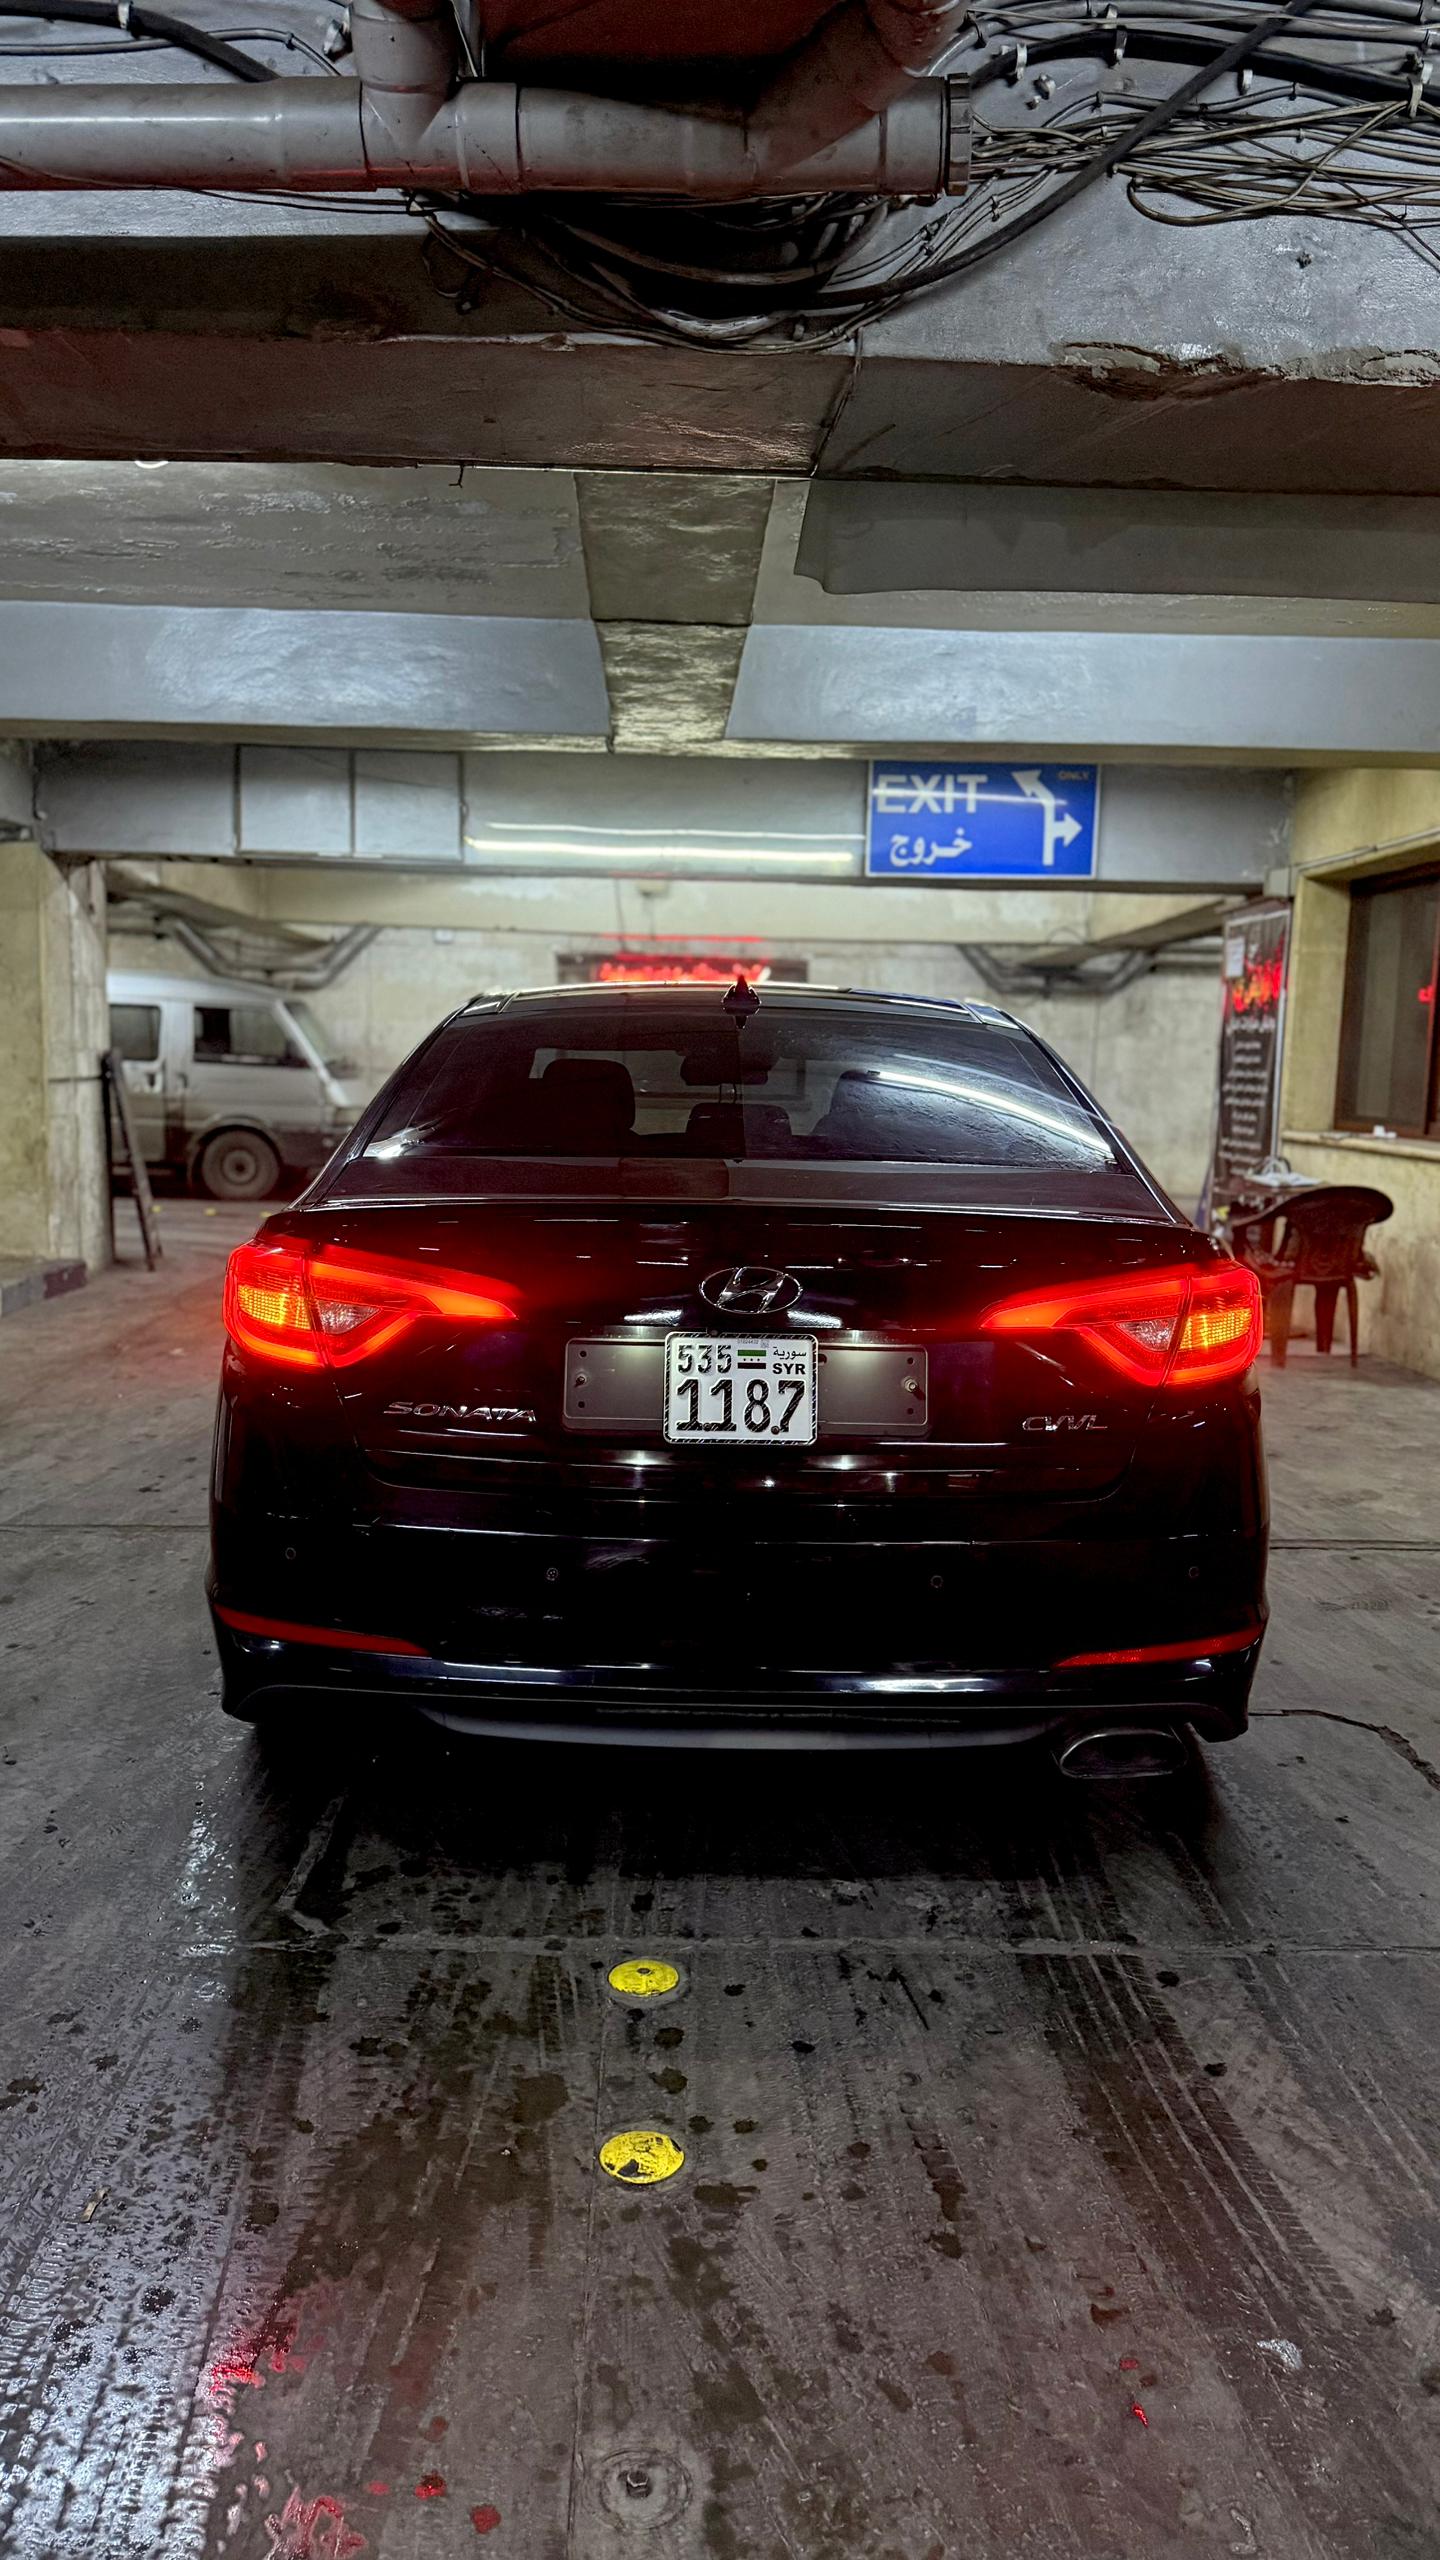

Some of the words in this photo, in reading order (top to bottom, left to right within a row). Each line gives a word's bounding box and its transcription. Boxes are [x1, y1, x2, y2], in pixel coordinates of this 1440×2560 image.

[1057, 770, 1089, 781] ONLY
[876, 774, 988, 814] EXIT
[889, 827, 973, 867] خروج
[677, 1344, 732, 1374] 535
[772, 1346, 807, 1361] سورية
[772, 1362, 806, 1375] SYR
[383, 1401, 537, 1422] SONATA
[676, 1378, 806, 1433] 1187
